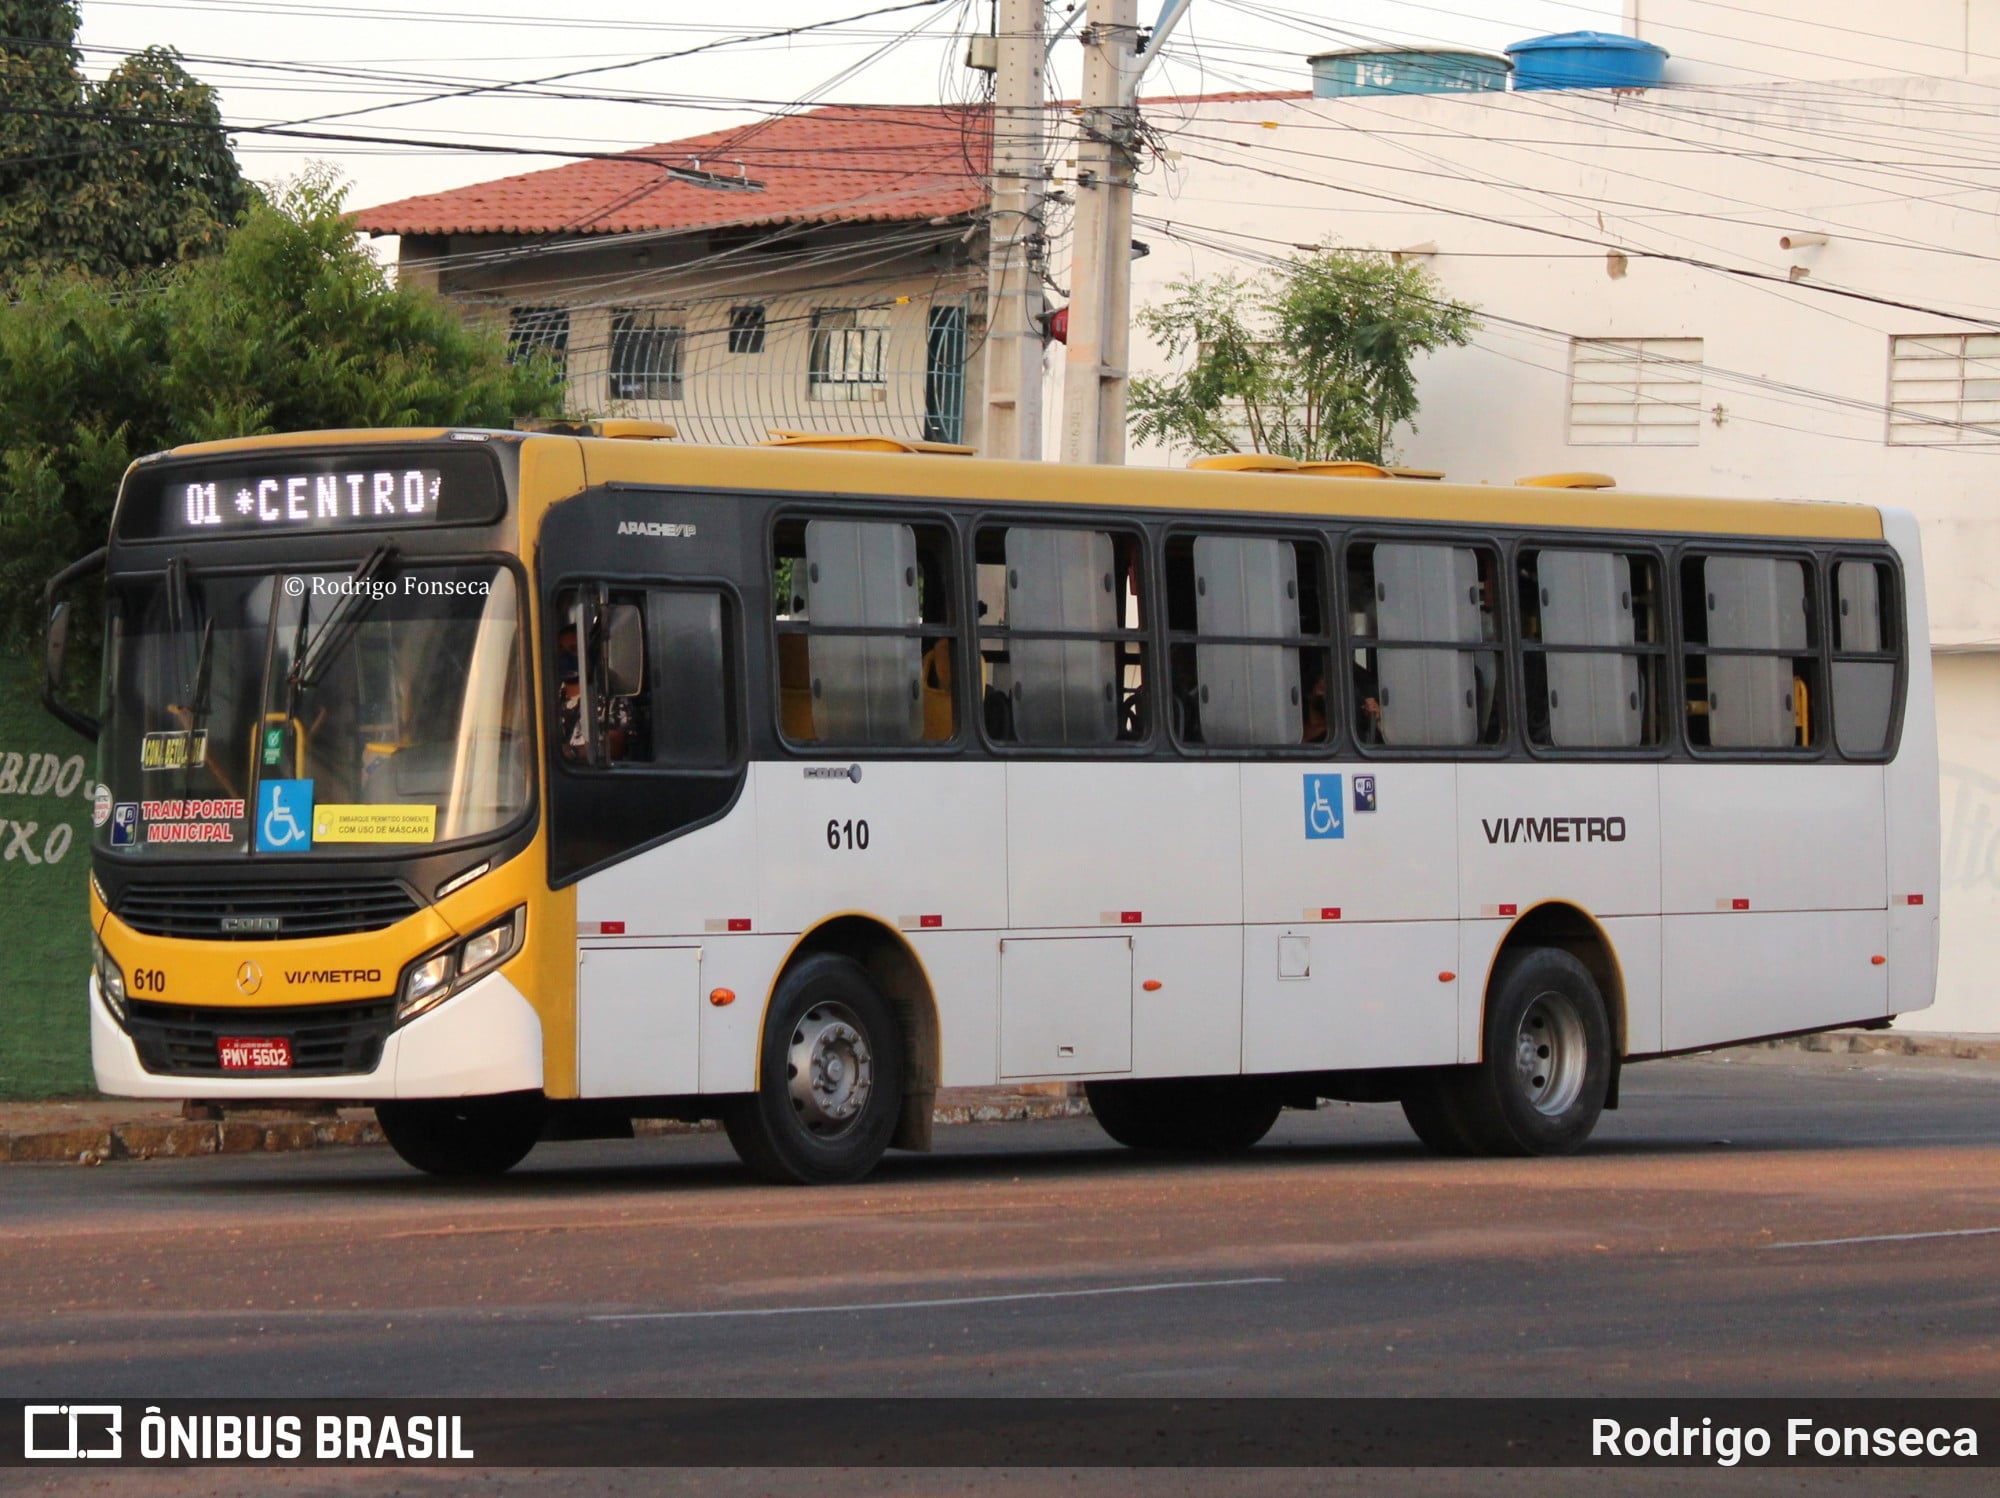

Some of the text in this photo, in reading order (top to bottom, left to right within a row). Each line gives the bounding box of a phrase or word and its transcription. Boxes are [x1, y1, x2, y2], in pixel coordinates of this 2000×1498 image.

[185, 483, 222, 525] 01
[0, 751, 85, 798] BIDO
[142, 800, 245, 820] TRANSPORTE
[339, 815, 430, 823] EMBARQUE PERMITIDO SOMENTE
[147, 822, 233, 842] MUNICIPAL
[339, 824, 429, 834] COM USO DE MÁSCARA
[827, 819, 869, 850] 610
[1481, 816, 1627, 844] VIAMETRO
[133, 968, 166, 993] 610
[284, 968, 381, 985] VIAMETRO
